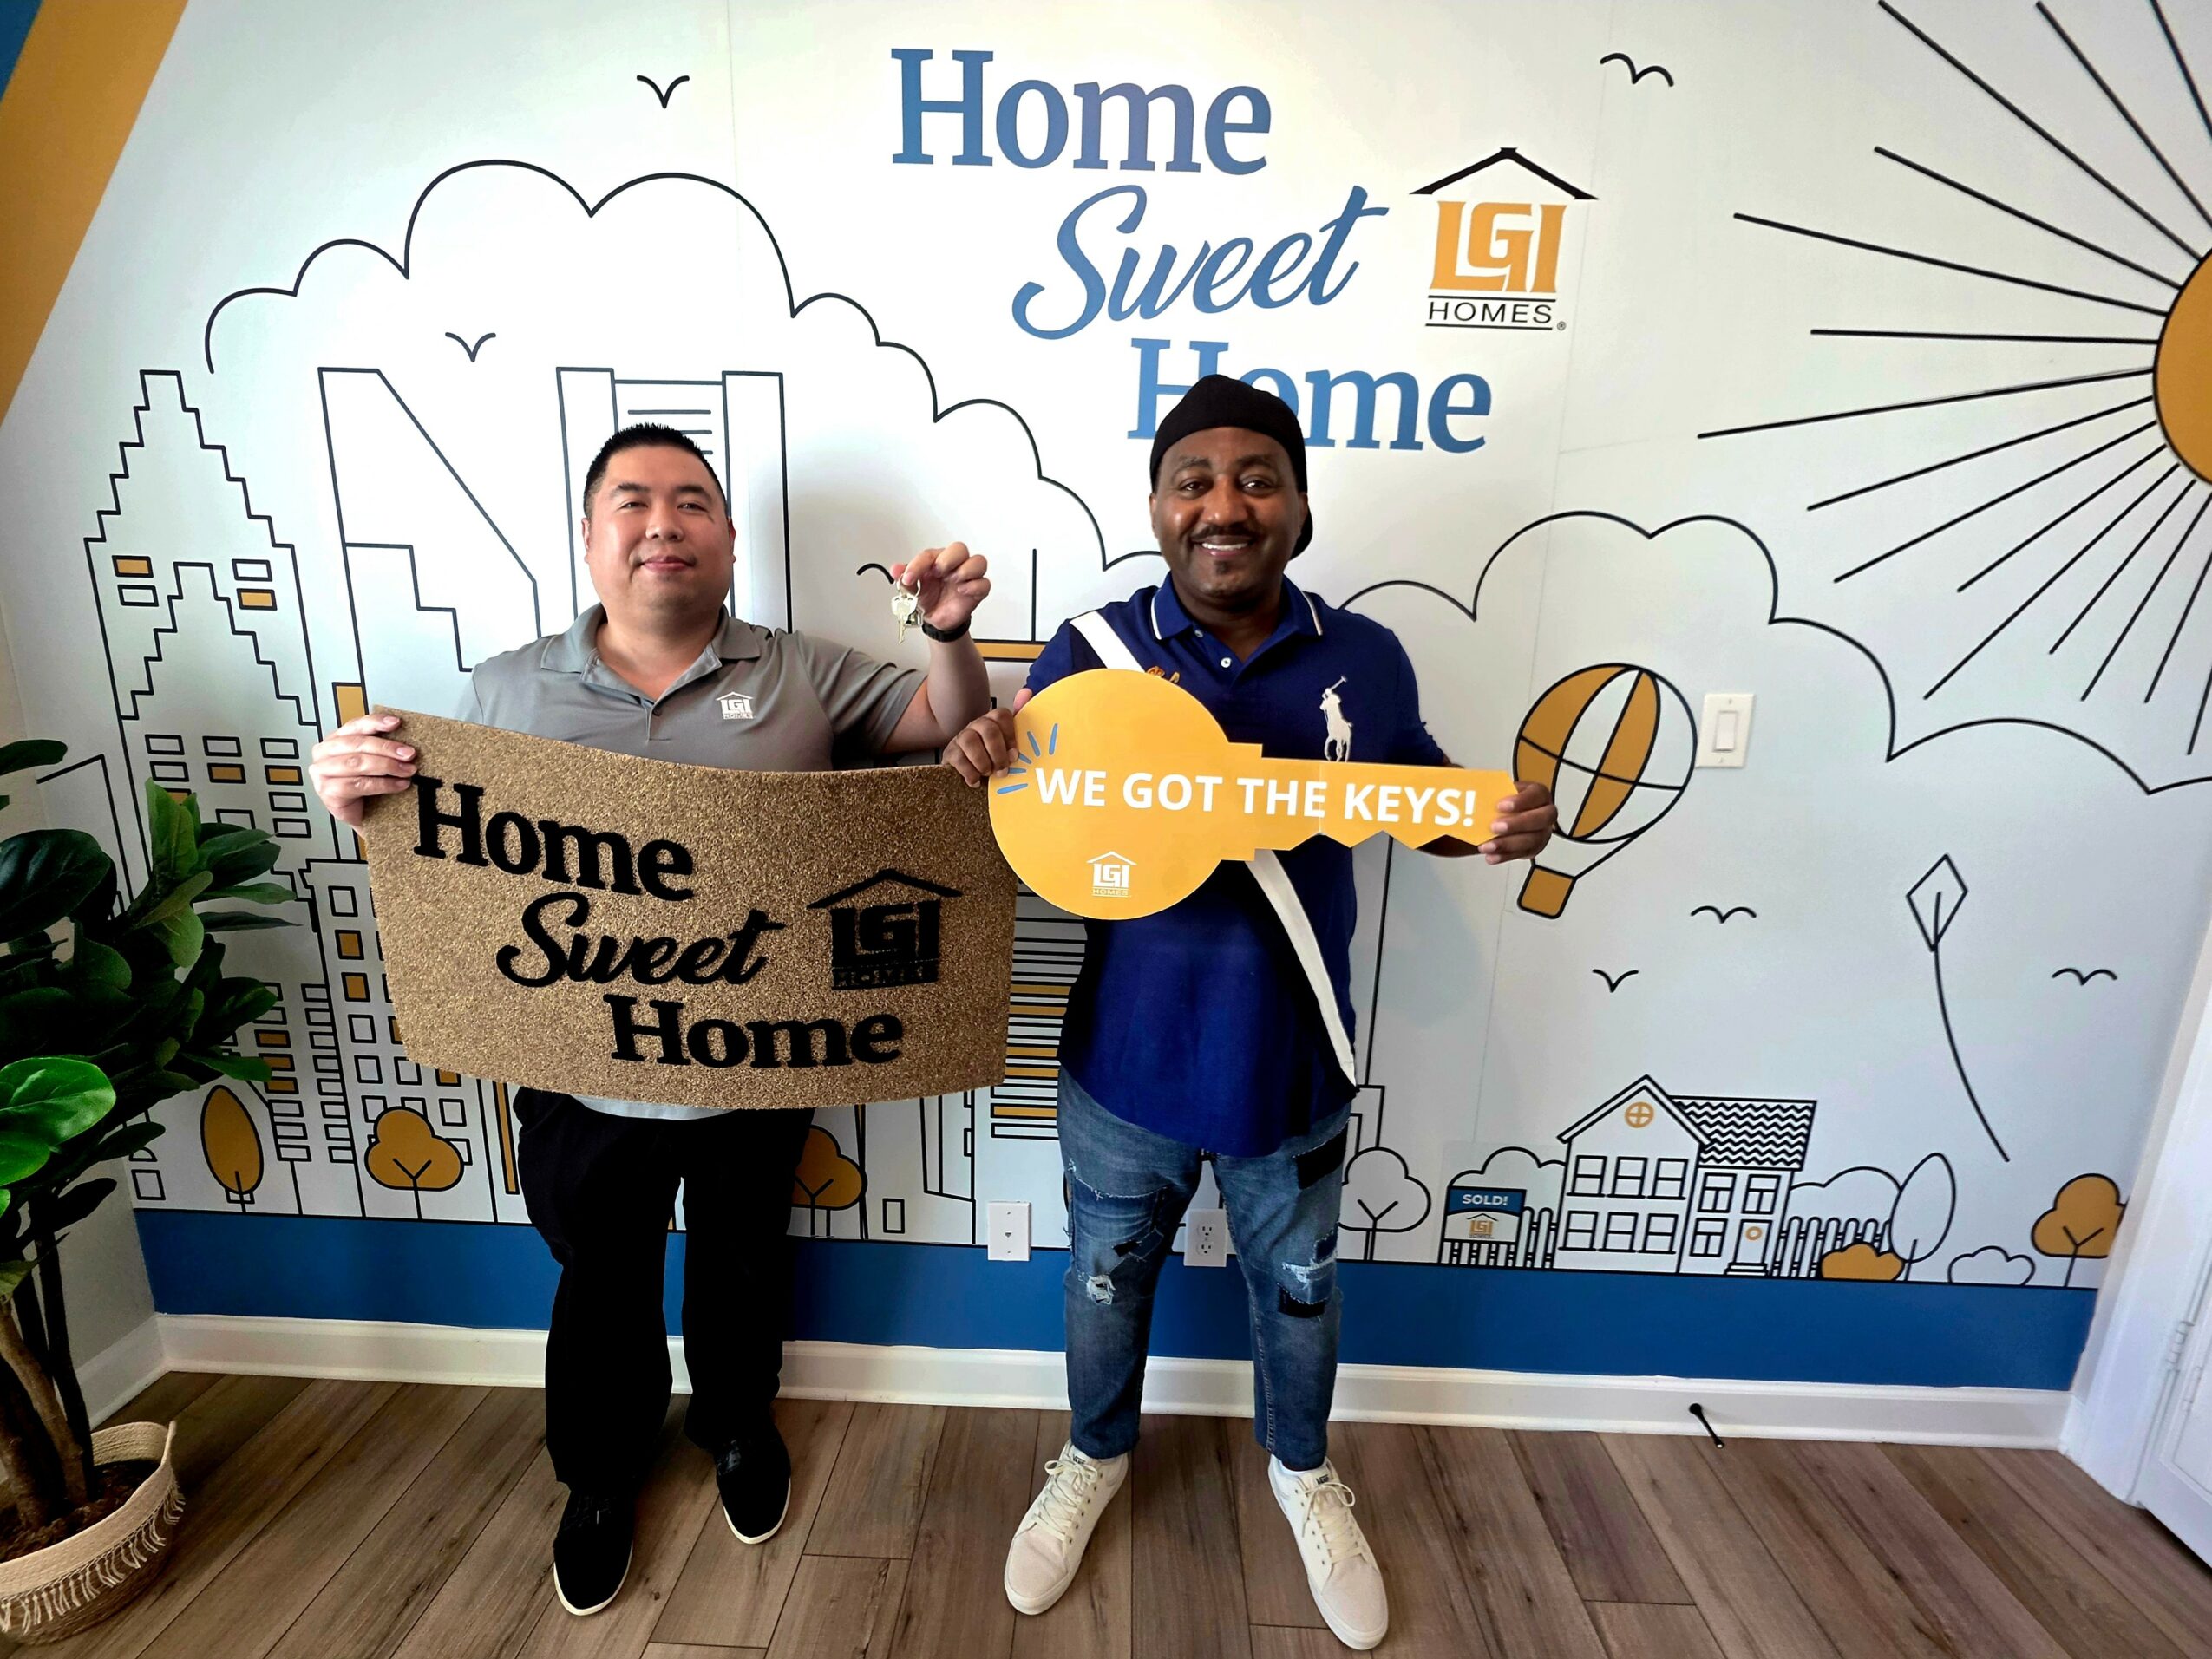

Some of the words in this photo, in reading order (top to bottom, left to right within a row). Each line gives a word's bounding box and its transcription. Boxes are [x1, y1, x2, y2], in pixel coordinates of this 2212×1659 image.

[891, 49, 1272, 175] Home
[1011, 185, 1389, 340] Sweet
[1429, 200, 1567, 293] LGI
[1428, 301, 1553, 323] HOMES
[720, 699, 752, 713] LGI
[1036, 768, 1107, 807] WE
[1122, 773, 1223, 812] GOT
[1237, 778, 1327, 818] THE
[1344, 784, 1476, 827] KEYS!
[411, 774, 693, 901] Home
[1092, 863, 1130, 887] LGI
[496, 891, 783, 988] Sweet
[830, 899, 941, 964] LGI
[603, 994, 903, 1068] Home
[1462, 1194, 1509, 1206] SOLD!
